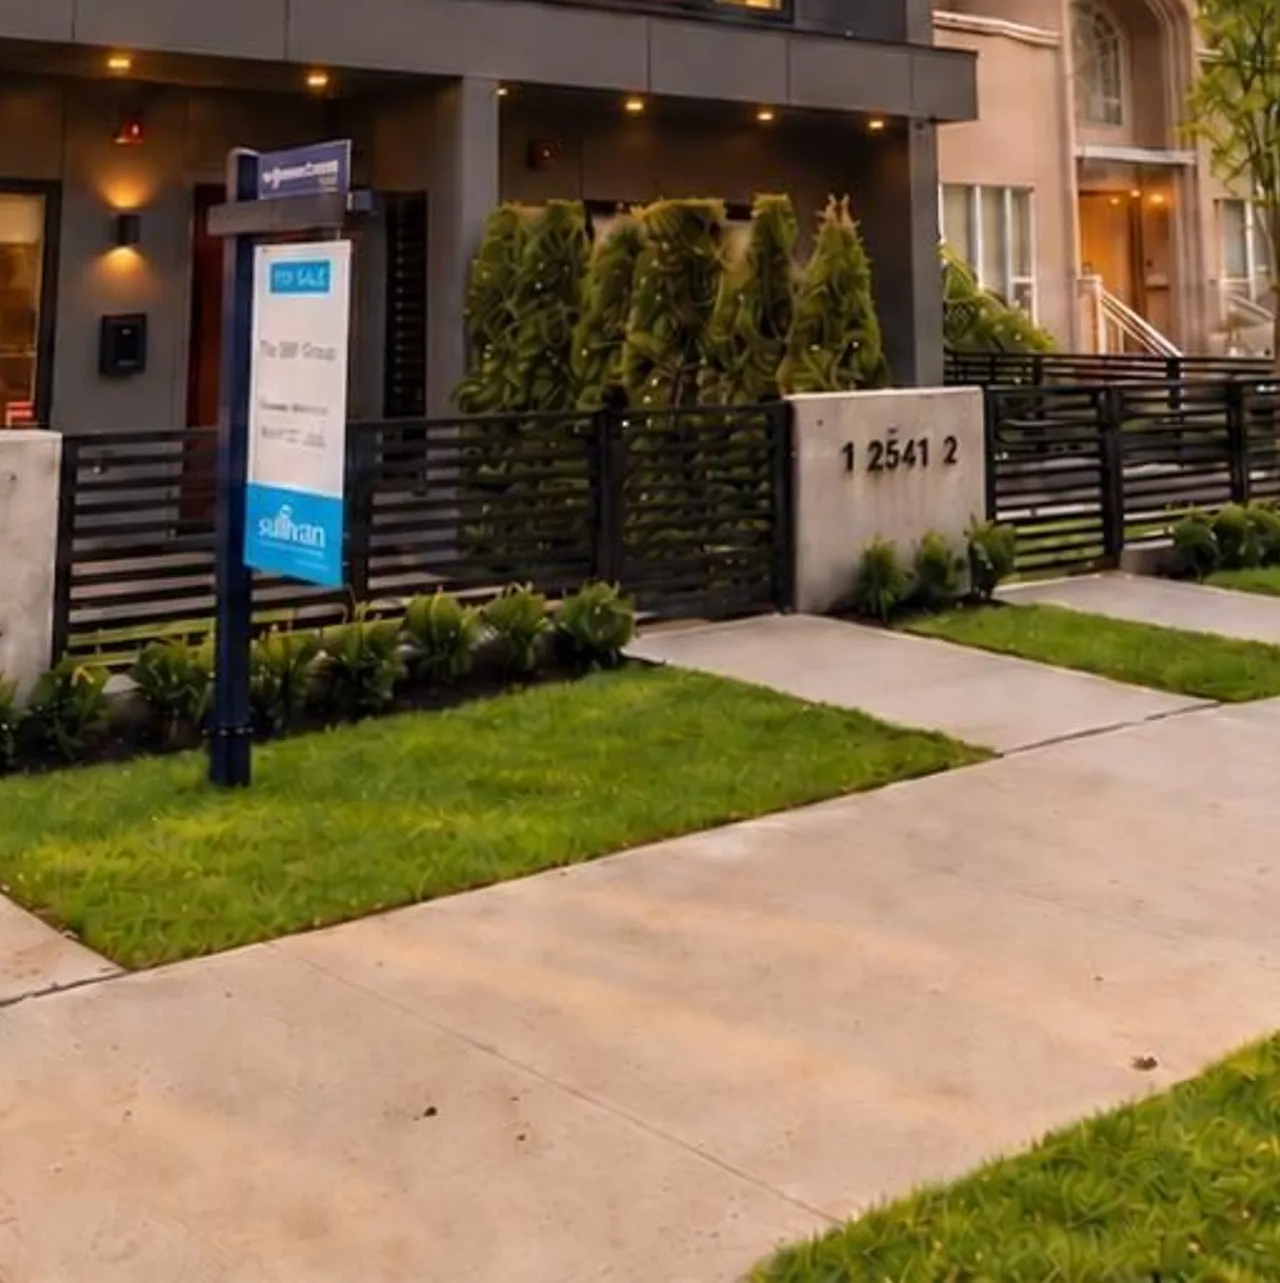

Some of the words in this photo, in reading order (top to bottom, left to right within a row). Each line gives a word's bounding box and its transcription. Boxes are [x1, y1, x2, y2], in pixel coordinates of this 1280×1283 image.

[842, 440, 854, 472] 1
[867, 437, 928, 472] 2541
[942, 435, 958, 465] 2
